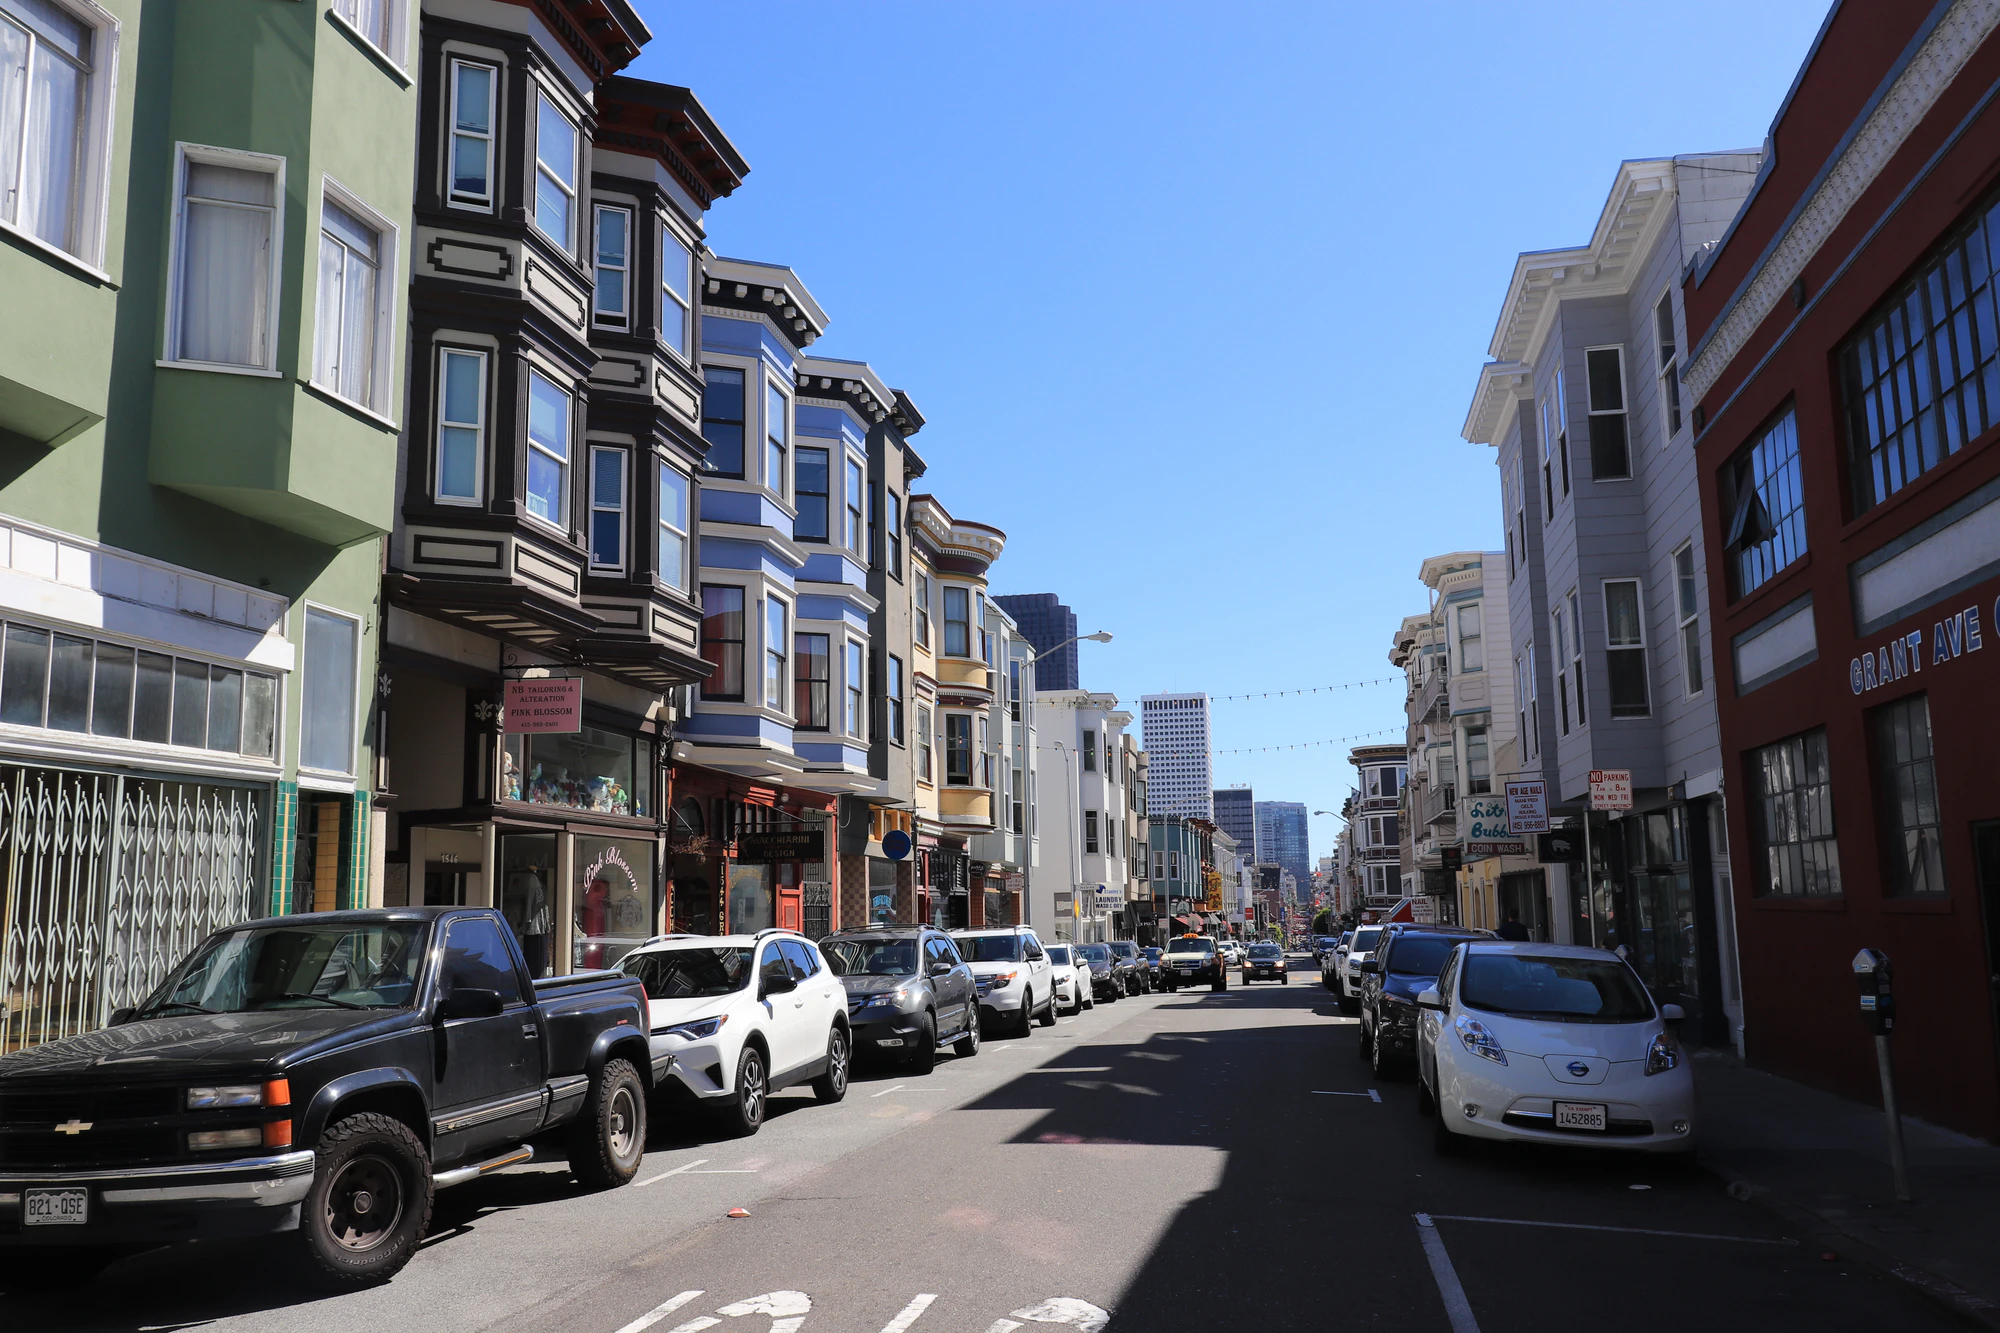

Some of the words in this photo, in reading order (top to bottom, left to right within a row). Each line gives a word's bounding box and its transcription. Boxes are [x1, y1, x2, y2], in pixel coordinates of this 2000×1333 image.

[1850, 629, 1922, 695] GRANT
[1933, 605, 1982, 665] AVE
[512, 686, 524, 694] NB
[511, 708, 531, 716] PINK
[1591, 771, 1602, 782] NO
[1509, 787, 1518, 795] NEW
[1520, 786, 1529, 795] AGE
[1530, 786, 1542, 794] NAILS
[751, 835, 810, 844] MACCHIARINI
[764, 849, 795, 857] DESIGN
[1471, 844, 1492, 853] COIN
[1497, 844, 1522, 853] WASH
[441, 854, 458, 863] 1546
[583, 851, 603, 894] Pink
[605, 846, 638, 892] Blossom
[1560, 1112, 1602, 1126] 1452885
[335, 1234, 405, 1266] BFGoodrich
